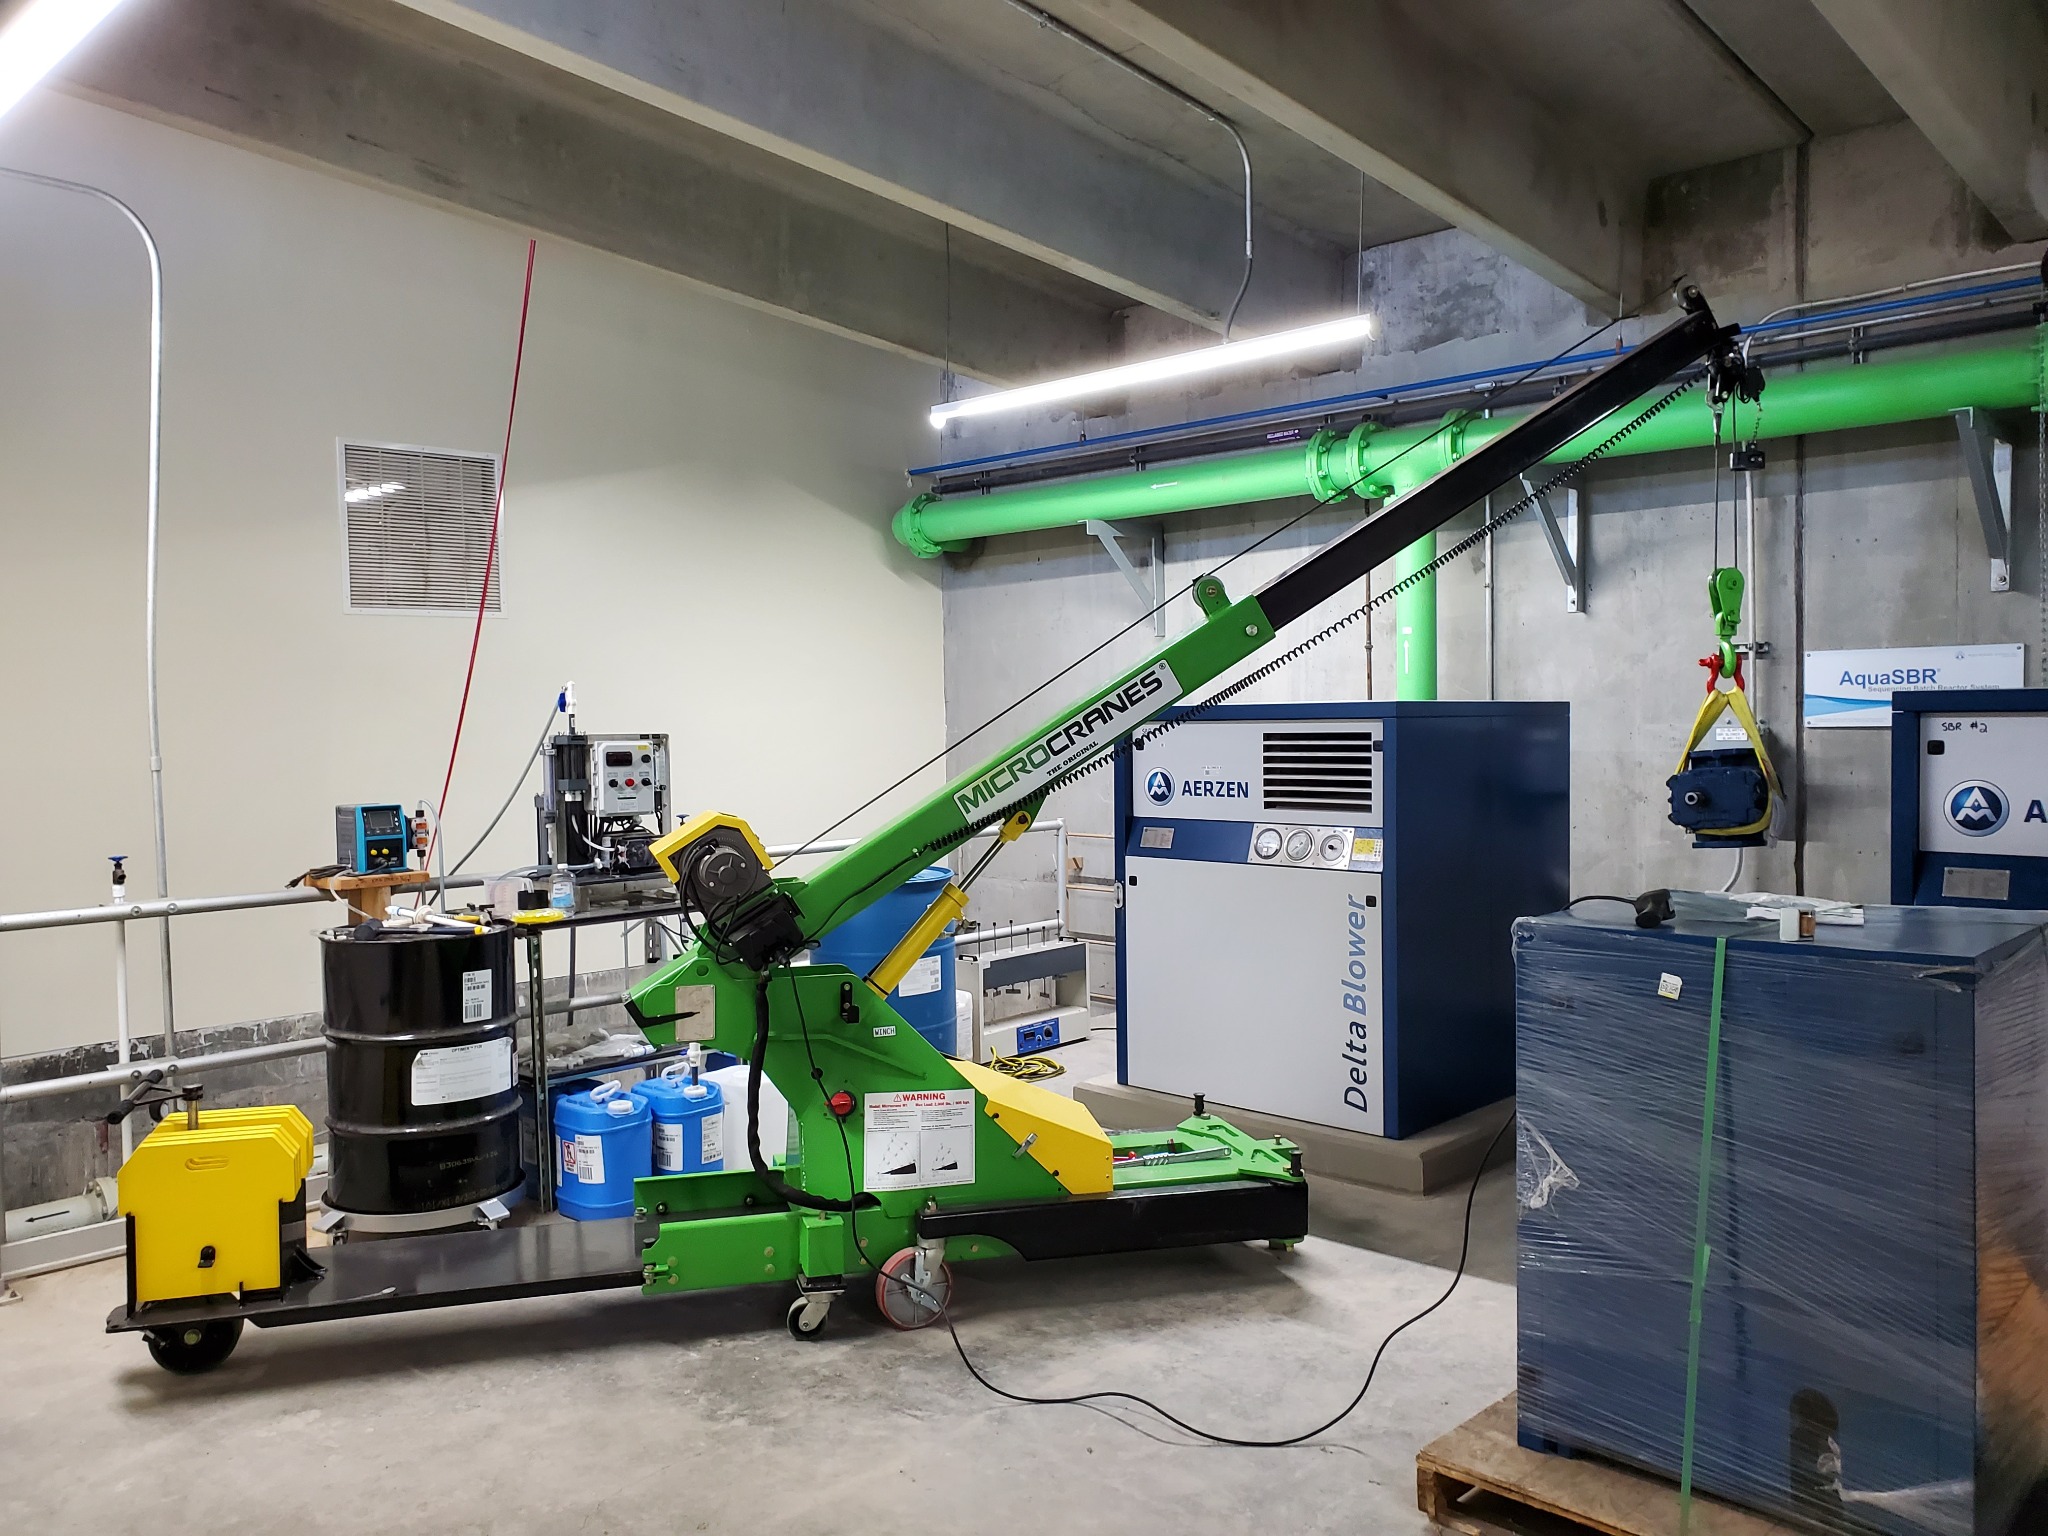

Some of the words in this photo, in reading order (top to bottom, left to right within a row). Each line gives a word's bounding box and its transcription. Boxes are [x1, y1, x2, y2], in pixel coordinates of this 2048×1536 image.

[1839, 668, 1937, 689] AquaSBR
[1941, 721, 1962, 732] SBR
[1970, 720, 1987, 733] #2
[957, 669, 1163, 815] MICROCRANES
[1046, 763, 1063, 777] THE
[1063, 740, 1099, 767] ORIGINAL
[1181, 780, 1249, 799] AERZEN
[1341, 893, 1367, 1016] Blower
[874, 1027, 895, 1037] WINCH
[1341, 1021, 1368, 1113] Delta
[902, 1092, 946, 1102] WARNING
